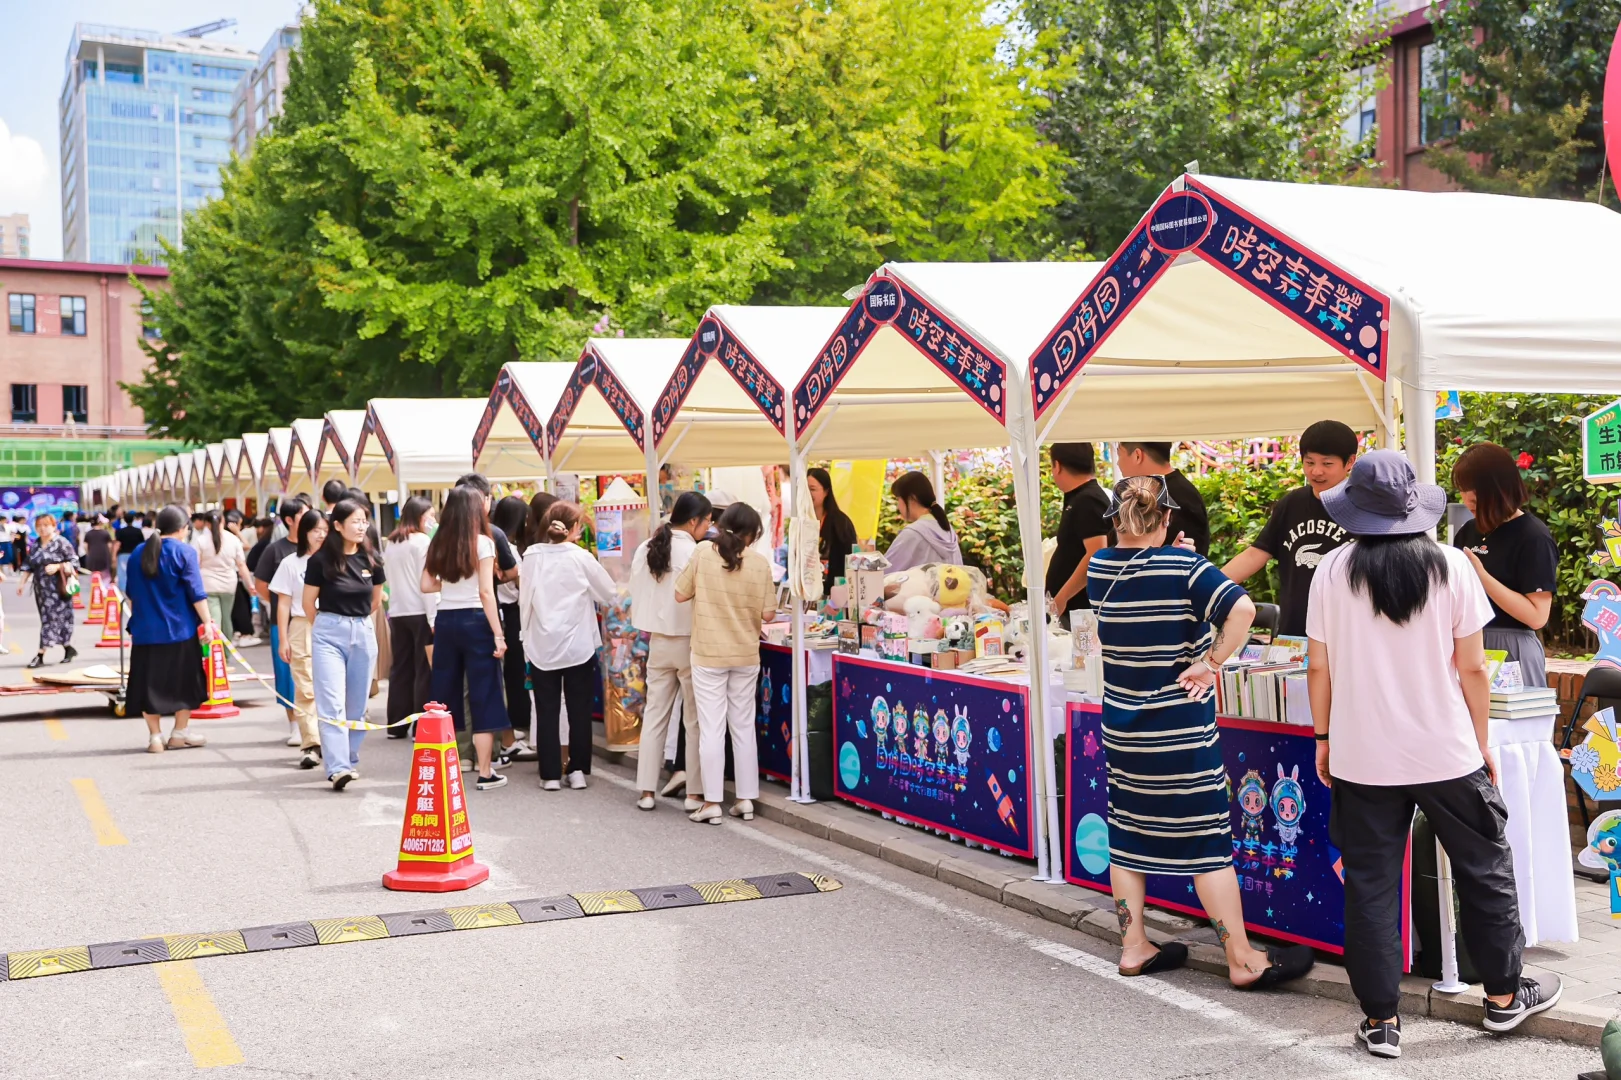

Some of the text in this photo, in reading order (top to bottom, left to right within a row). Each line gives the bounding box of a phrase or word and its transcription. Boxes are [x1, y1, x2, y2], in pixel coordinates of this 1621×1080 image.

[870, 293, 895, 307] 国际书店
[1283, 519, 1347, 552] LACOSTE
[1593, 605, 1621, 640] 理
[416, 765, 435, 811] 潜水艇
[411, 813, 438, 827] 角阀
[402, 838, 444, 852] 4006571282
